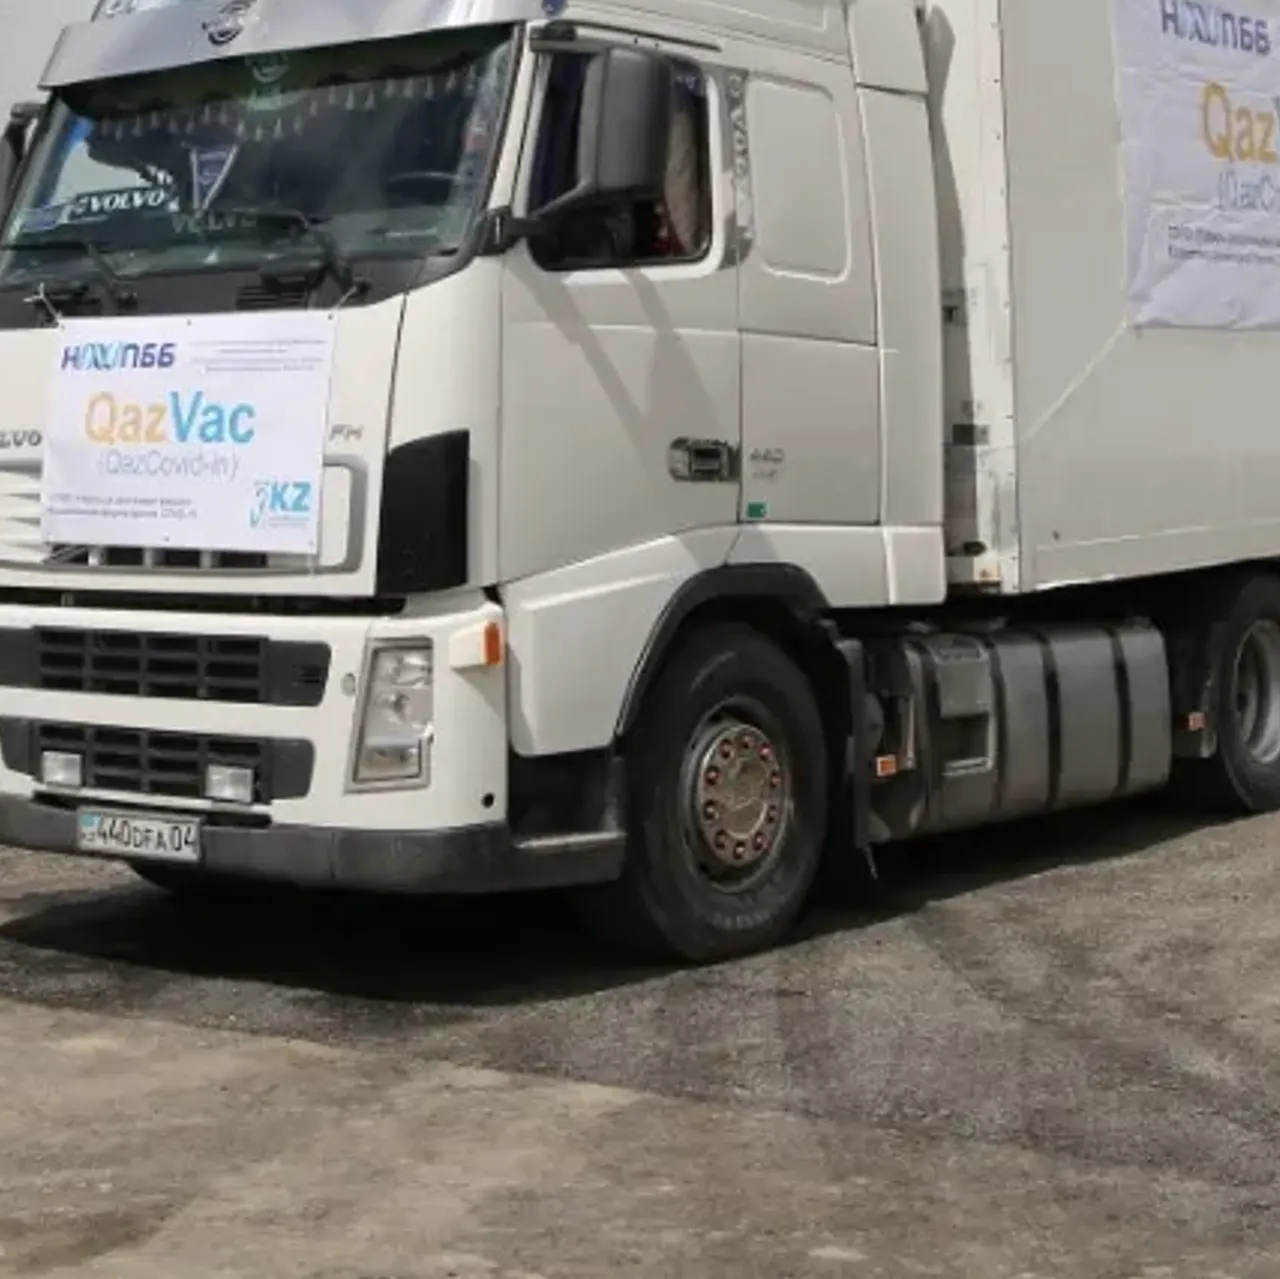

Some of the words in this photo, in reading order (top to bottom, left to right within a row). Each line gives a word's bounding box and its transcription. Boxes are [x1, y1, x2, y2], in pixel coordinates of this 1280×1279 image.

[89, 190, 166, 214] VOLVO
[85, 391, 255, 444] QazVac
[271, 483, 311, 512] KZ
